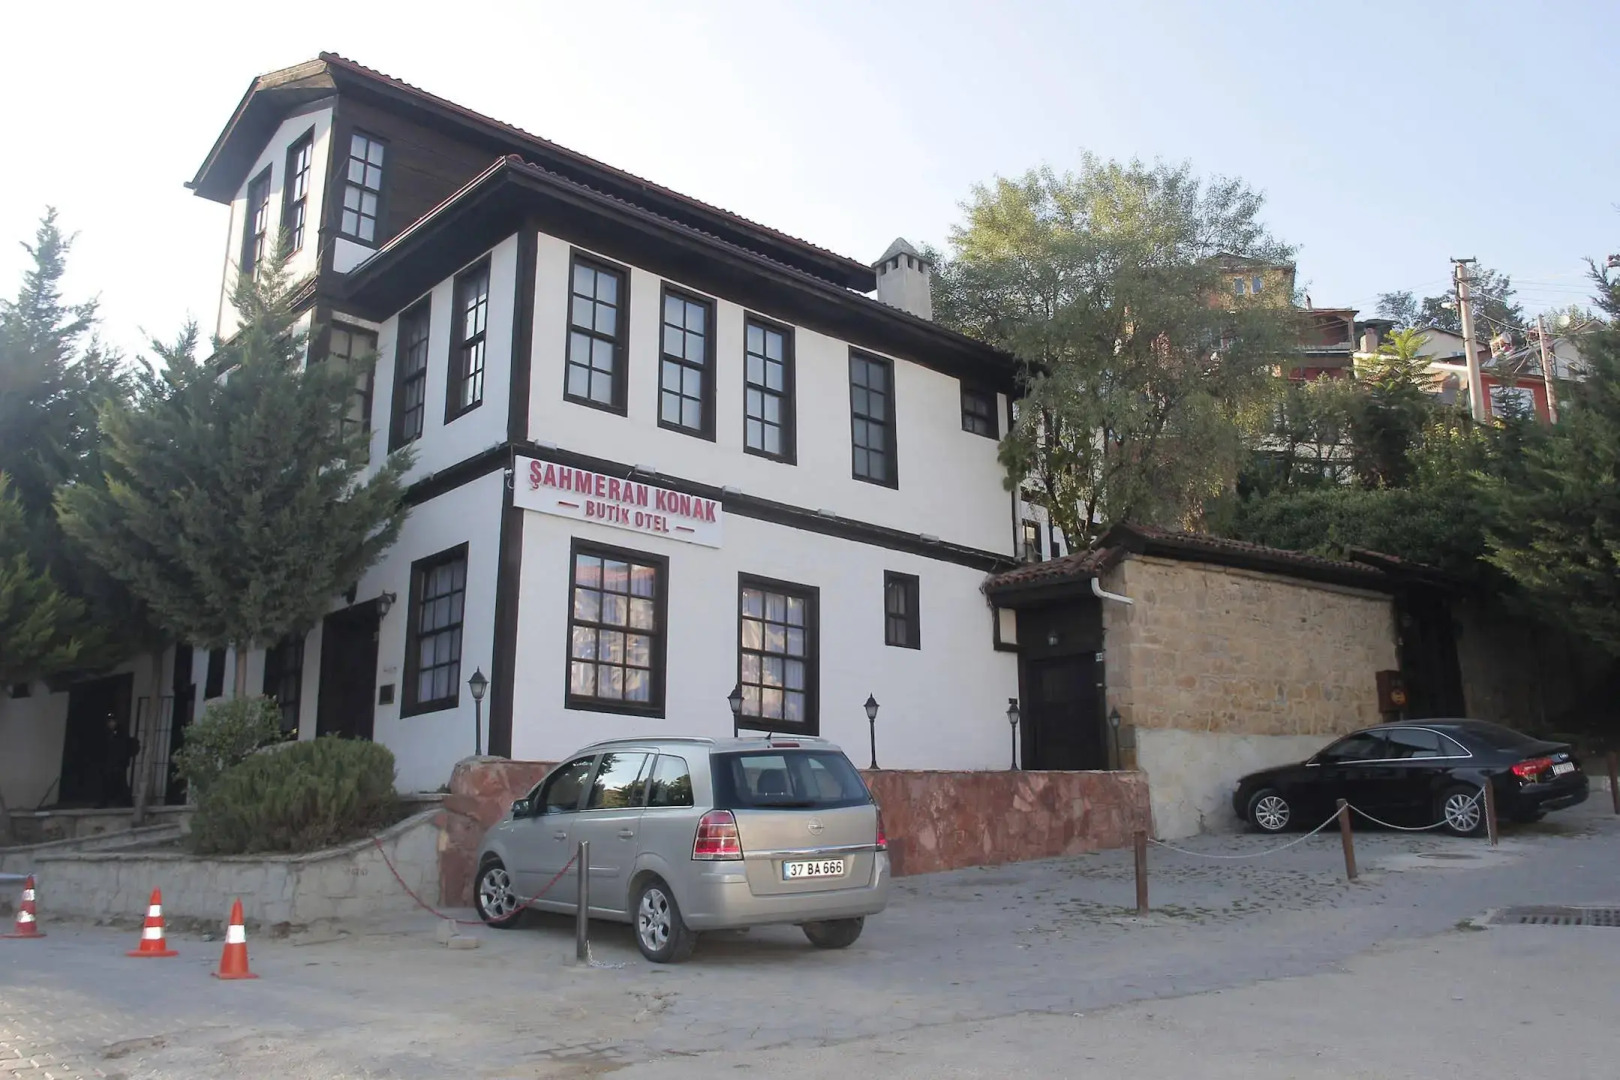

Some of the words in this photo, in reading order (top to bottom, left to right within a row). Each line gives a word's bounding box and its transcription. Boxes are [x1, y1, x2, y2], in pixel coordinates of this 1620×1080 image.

[529, 459, 649, 507] ŞAHMERAN
[656, 489, 717, 523] KONAK
[585, 500, 630, 525] BUTİK
[635, 511, 670, 533] OTEL
[790, 863, 804, 876] 37
[807, 862, 821, 875] BA
[823, 861, 842, 874] 666
